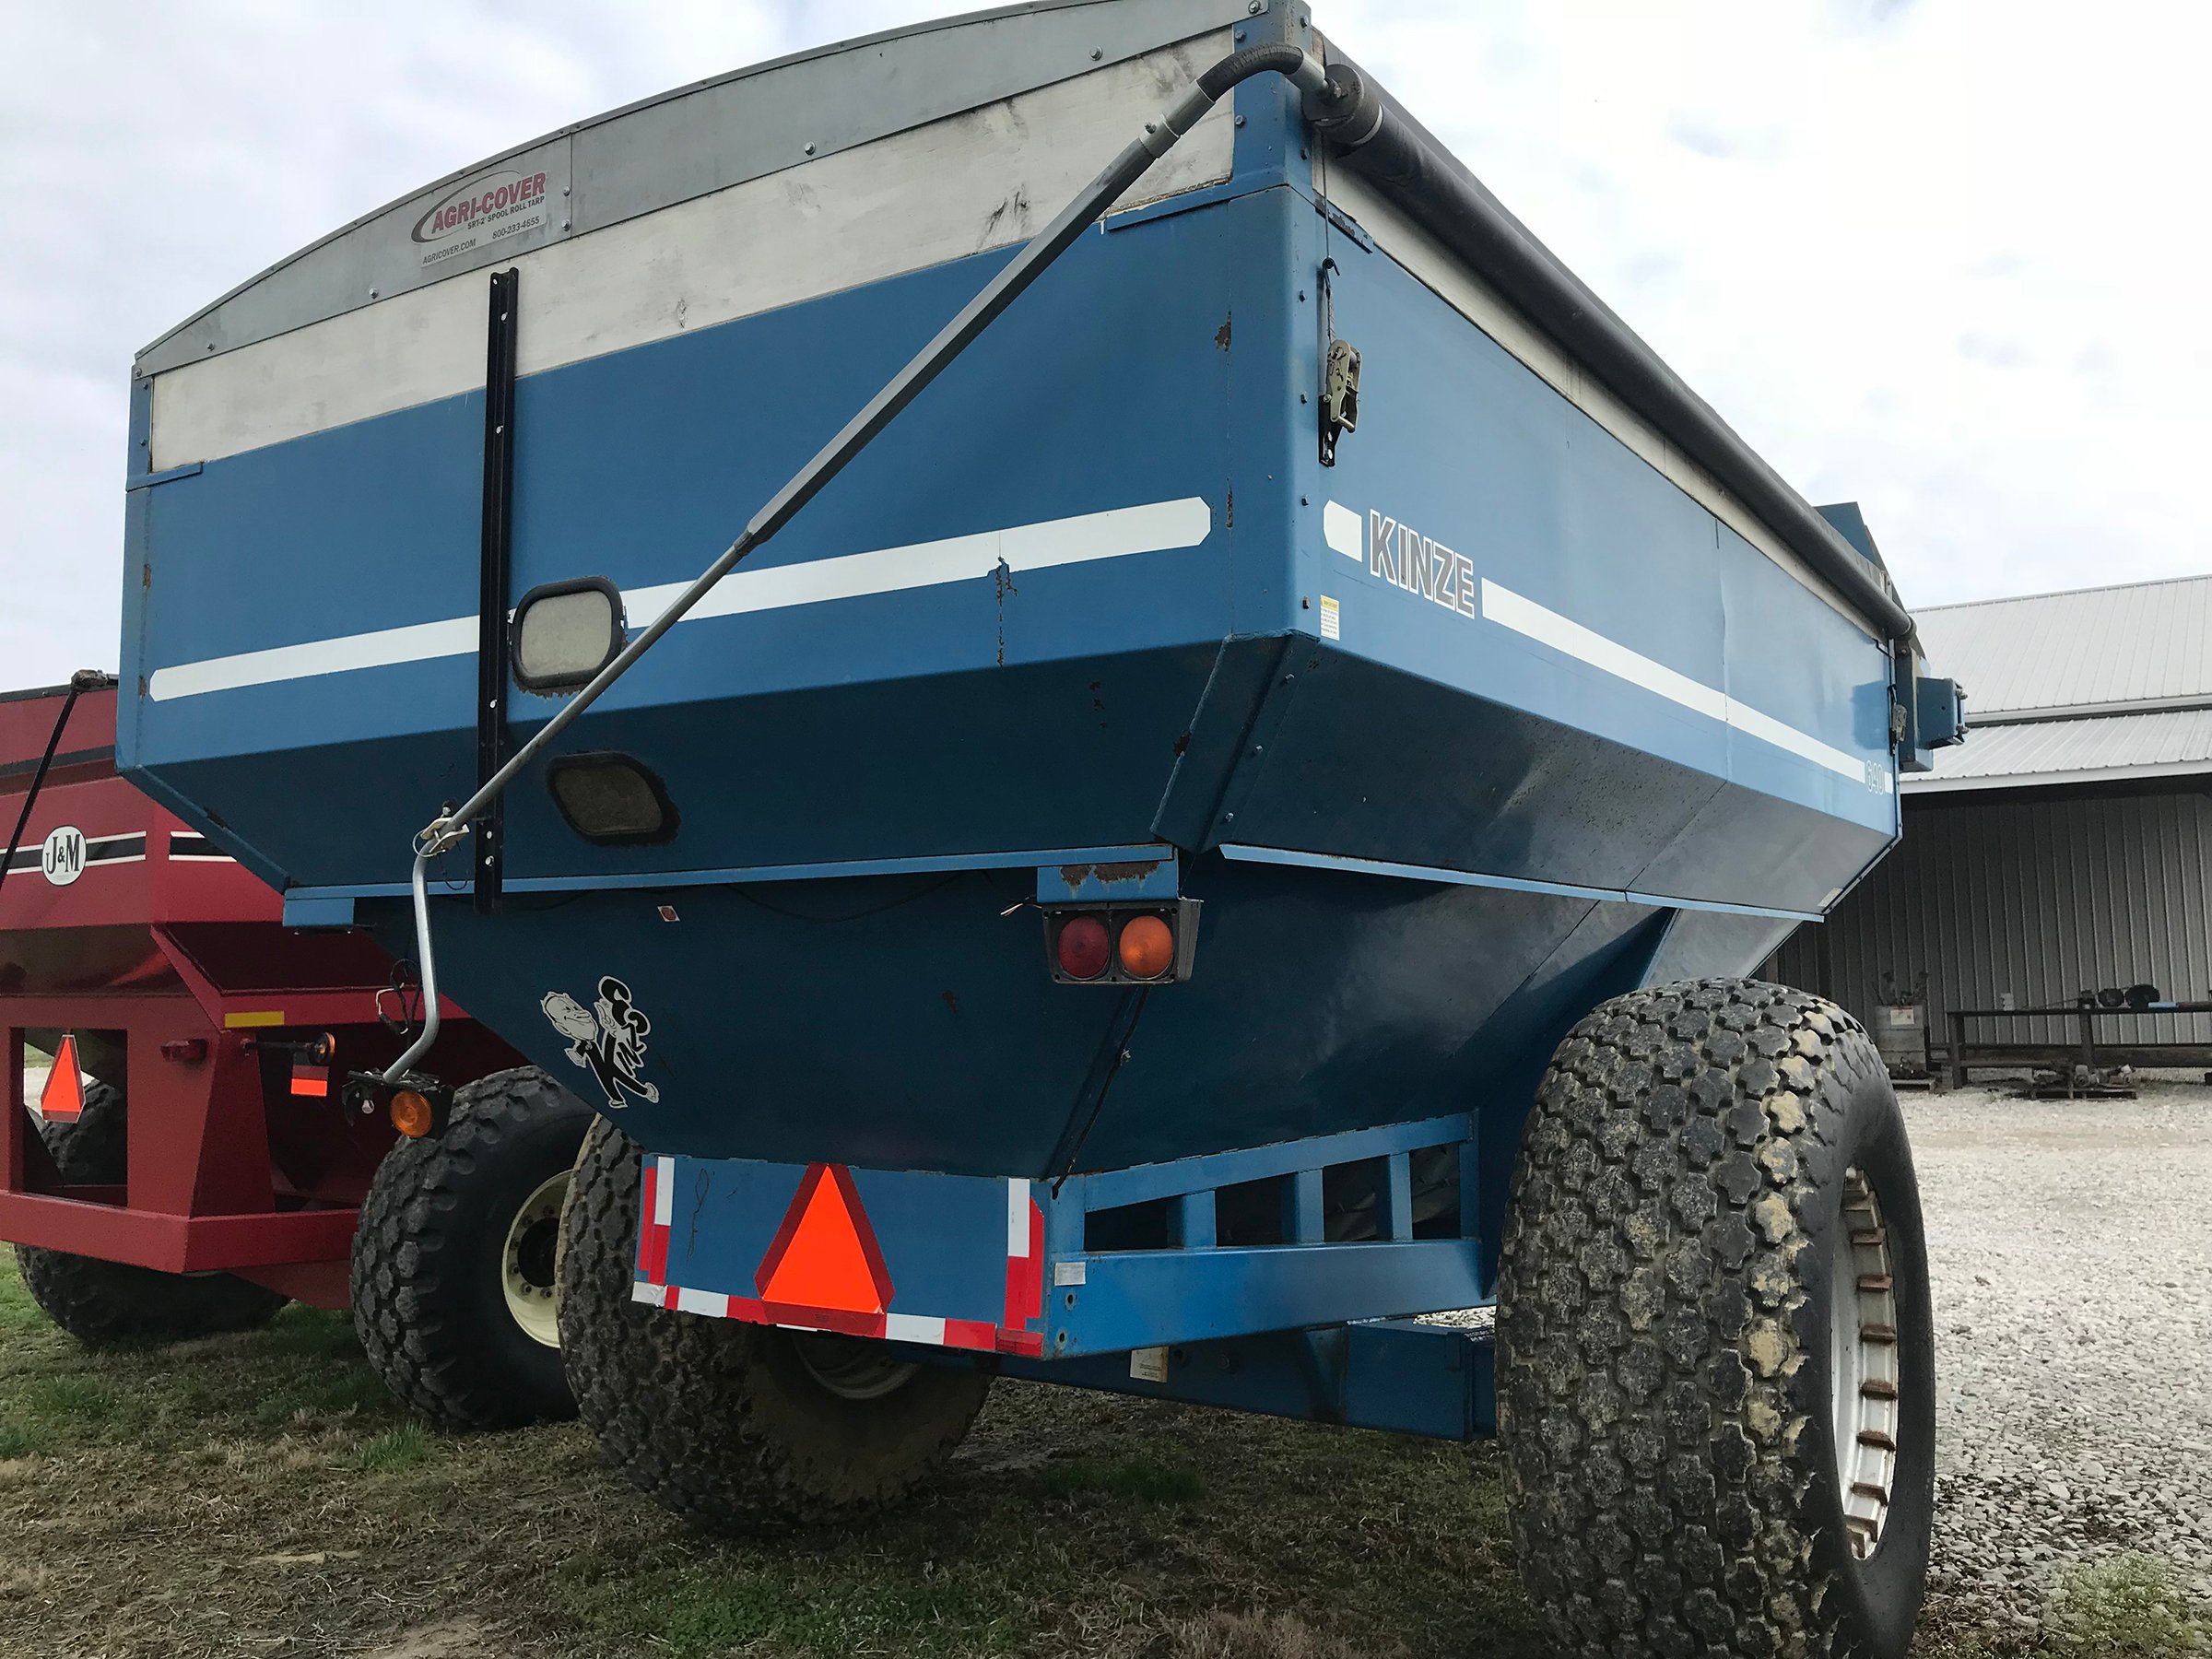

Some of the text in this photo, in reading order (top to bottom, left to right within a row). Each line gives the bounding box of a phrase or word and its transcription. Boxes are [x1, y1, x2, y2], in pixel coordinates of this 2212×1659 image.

[431, 172, 546, 233] AGRI-COVER
[488, 208, 509, 222] SPOOL
[510, 203, 526, 214] ROLL
[527, 196, 545, 208] TARP
[492, 216, 540, 240] 800-233-4655
[422, 239, 477, 265] AGRICOVER.COM
[1370, 508, 1475, 619] KINZE
[46, 834, 80, 874] J&M
